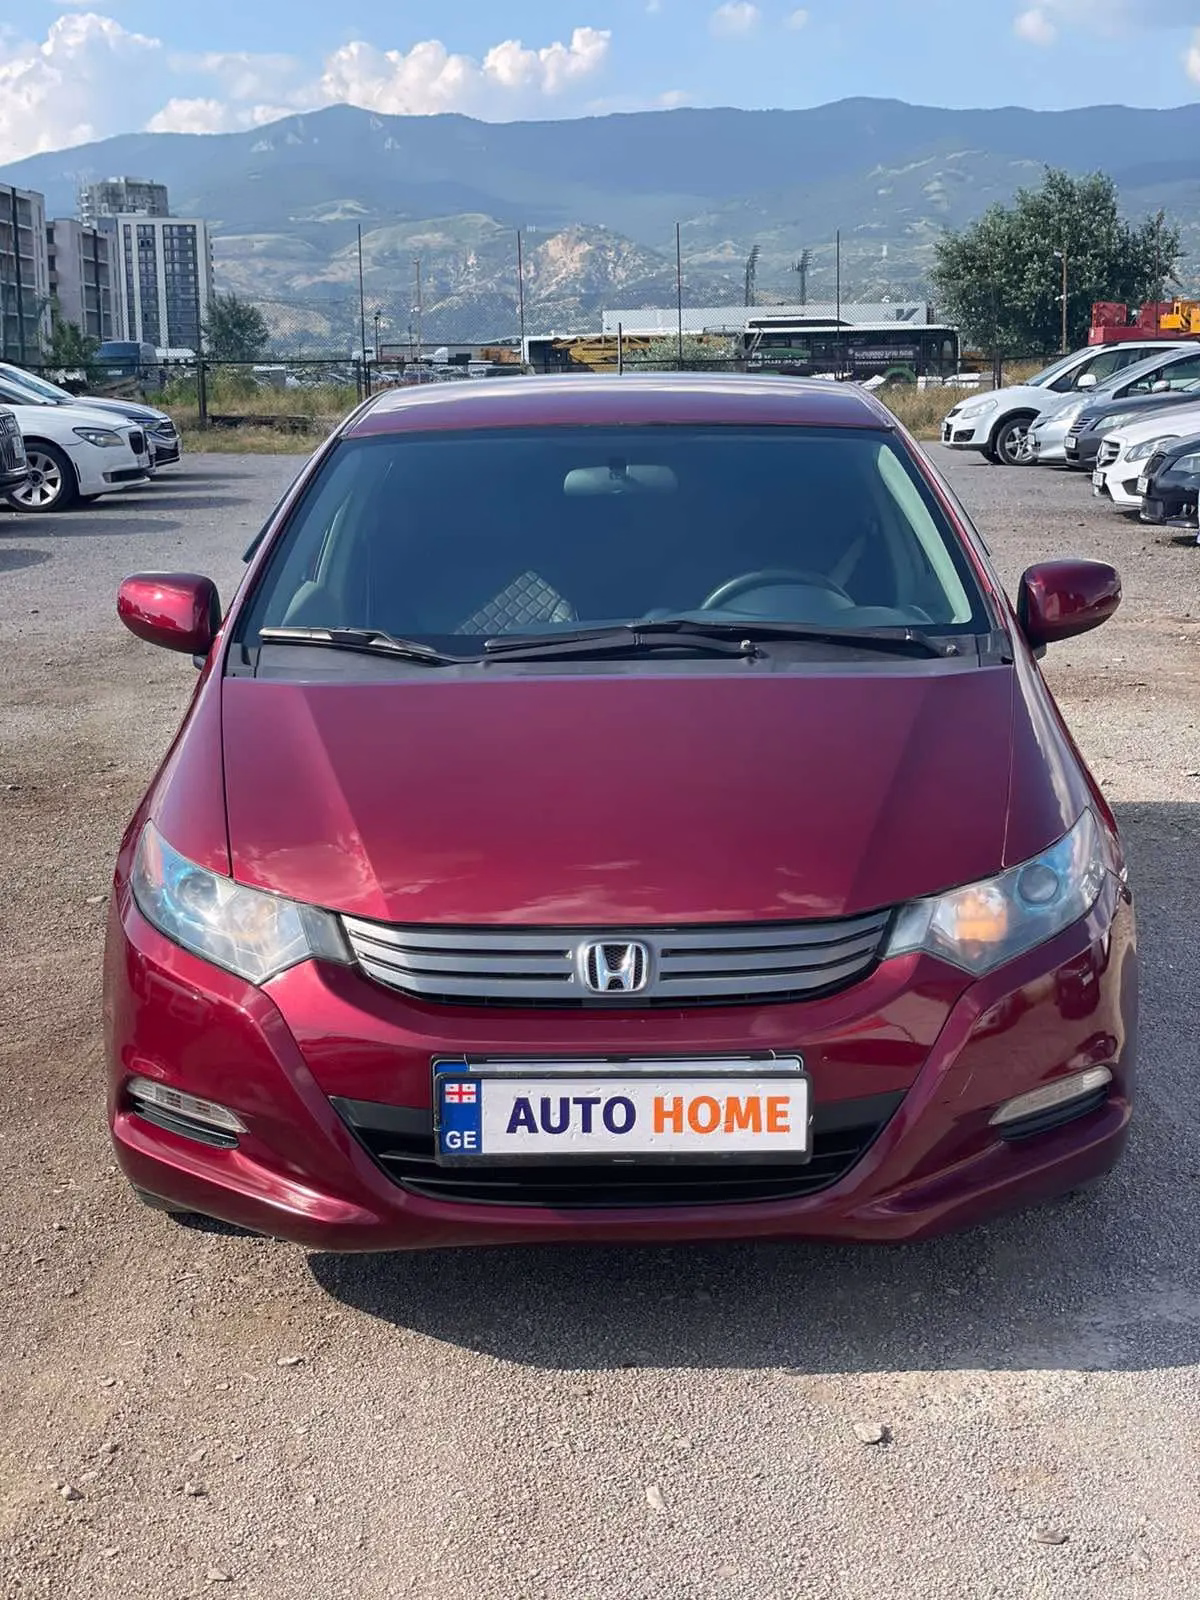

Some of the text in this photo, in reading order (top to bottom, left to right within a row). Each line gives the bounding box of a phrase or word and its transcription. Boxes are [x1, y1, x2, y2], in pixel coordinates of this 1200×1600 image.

[505, 1096, 791, 1135] AUTO HOME
[445, 1130, 477, 1149] GE
